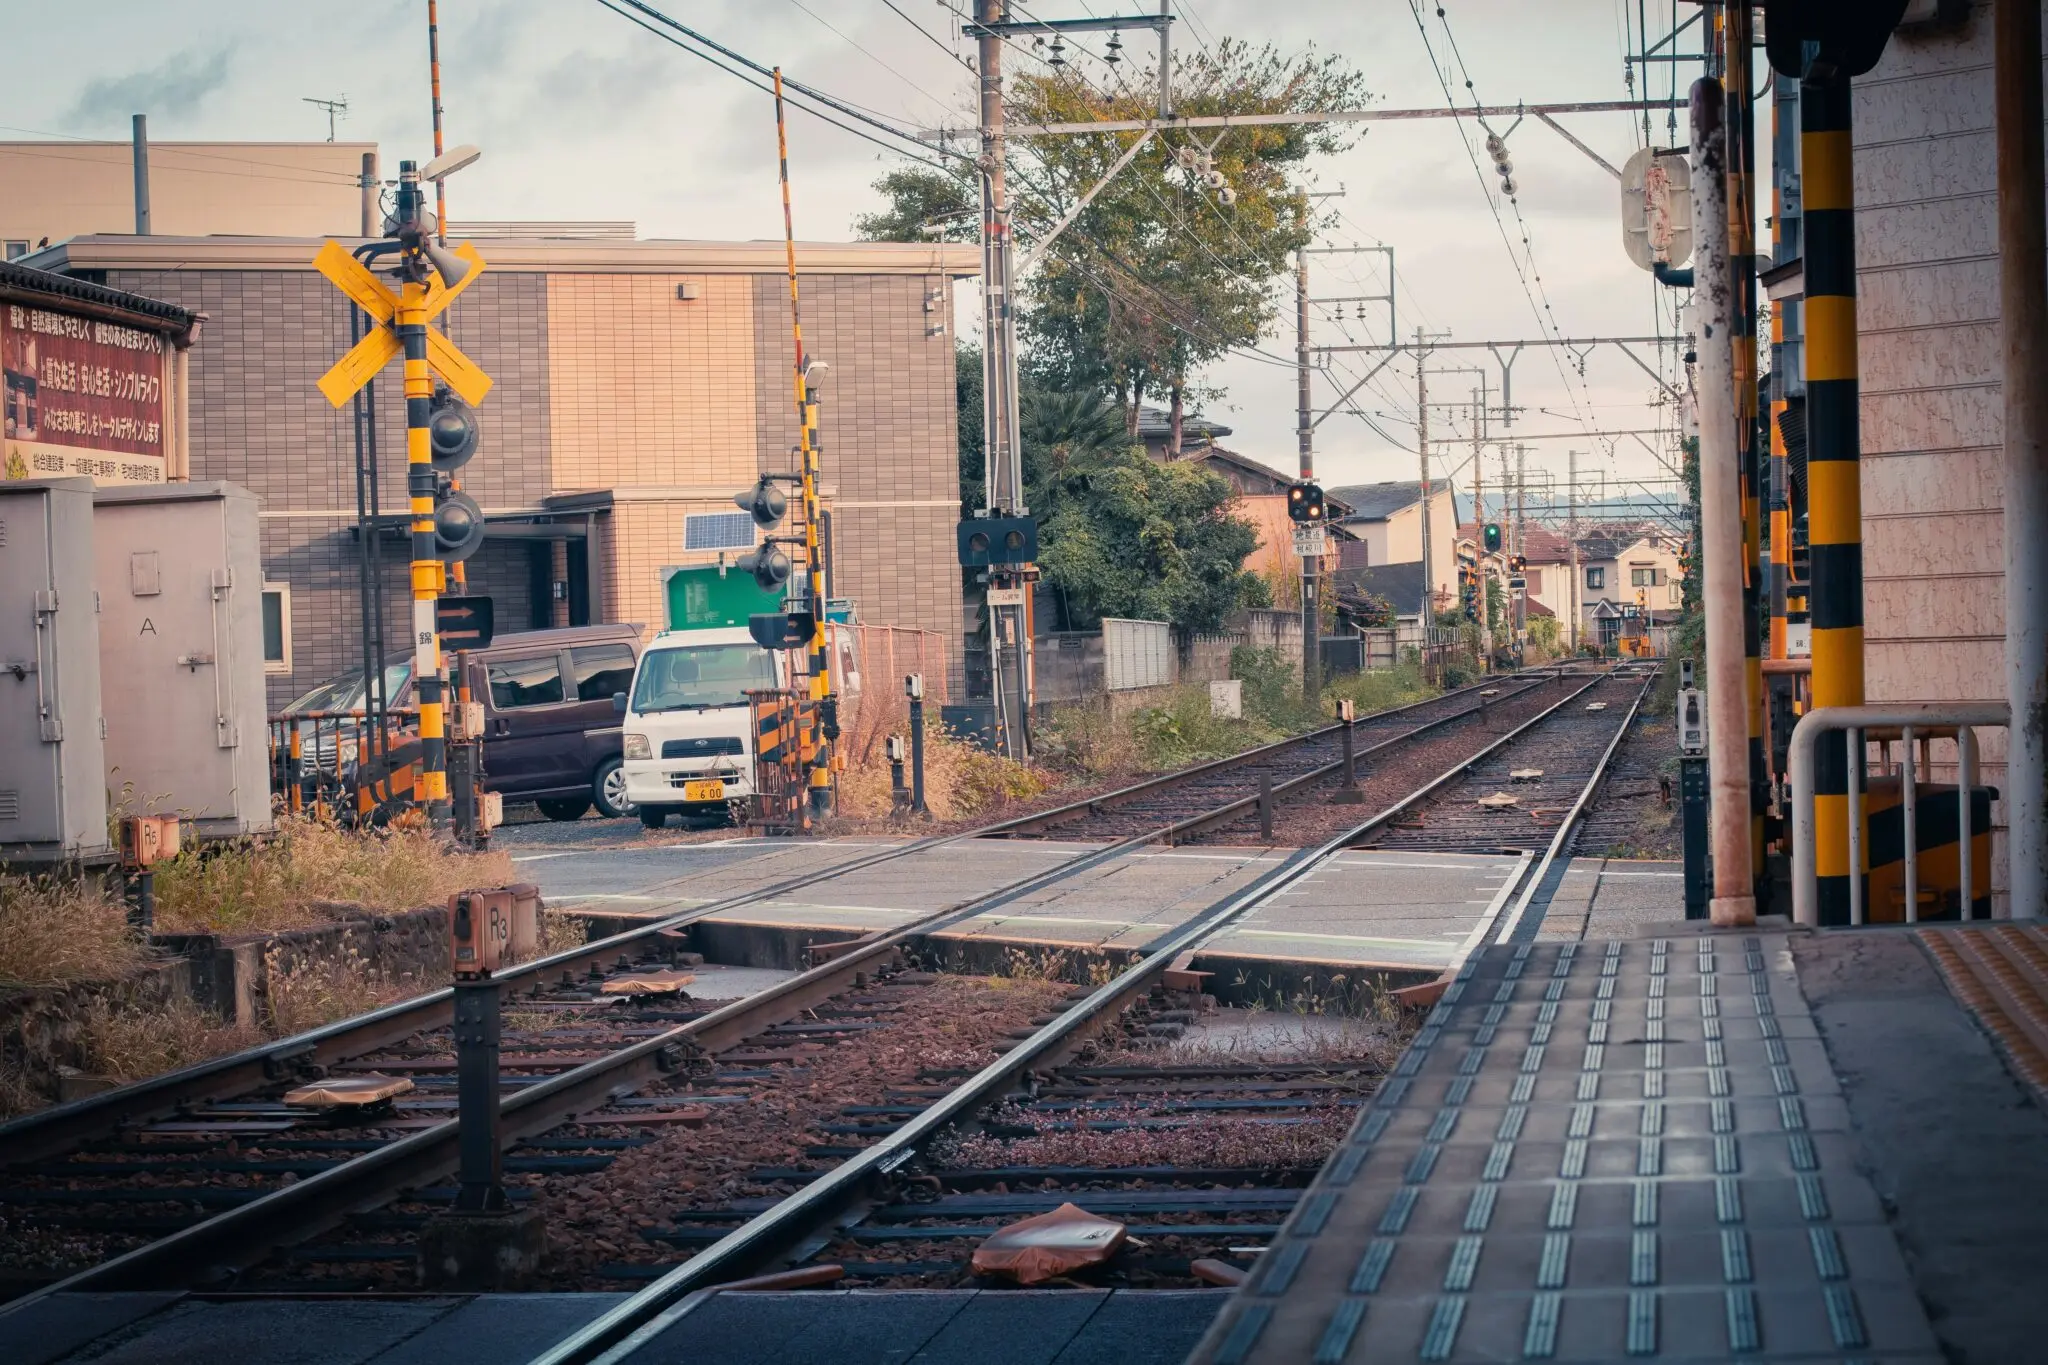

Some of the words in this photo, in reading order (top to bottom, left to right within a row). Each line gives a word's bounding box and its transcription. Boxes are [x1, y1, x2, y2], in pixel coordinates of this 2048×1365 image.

[140, 617, 156, 635] A
[419, 631, 432, 645] 錦
[490, 907, 507, 941] R3
